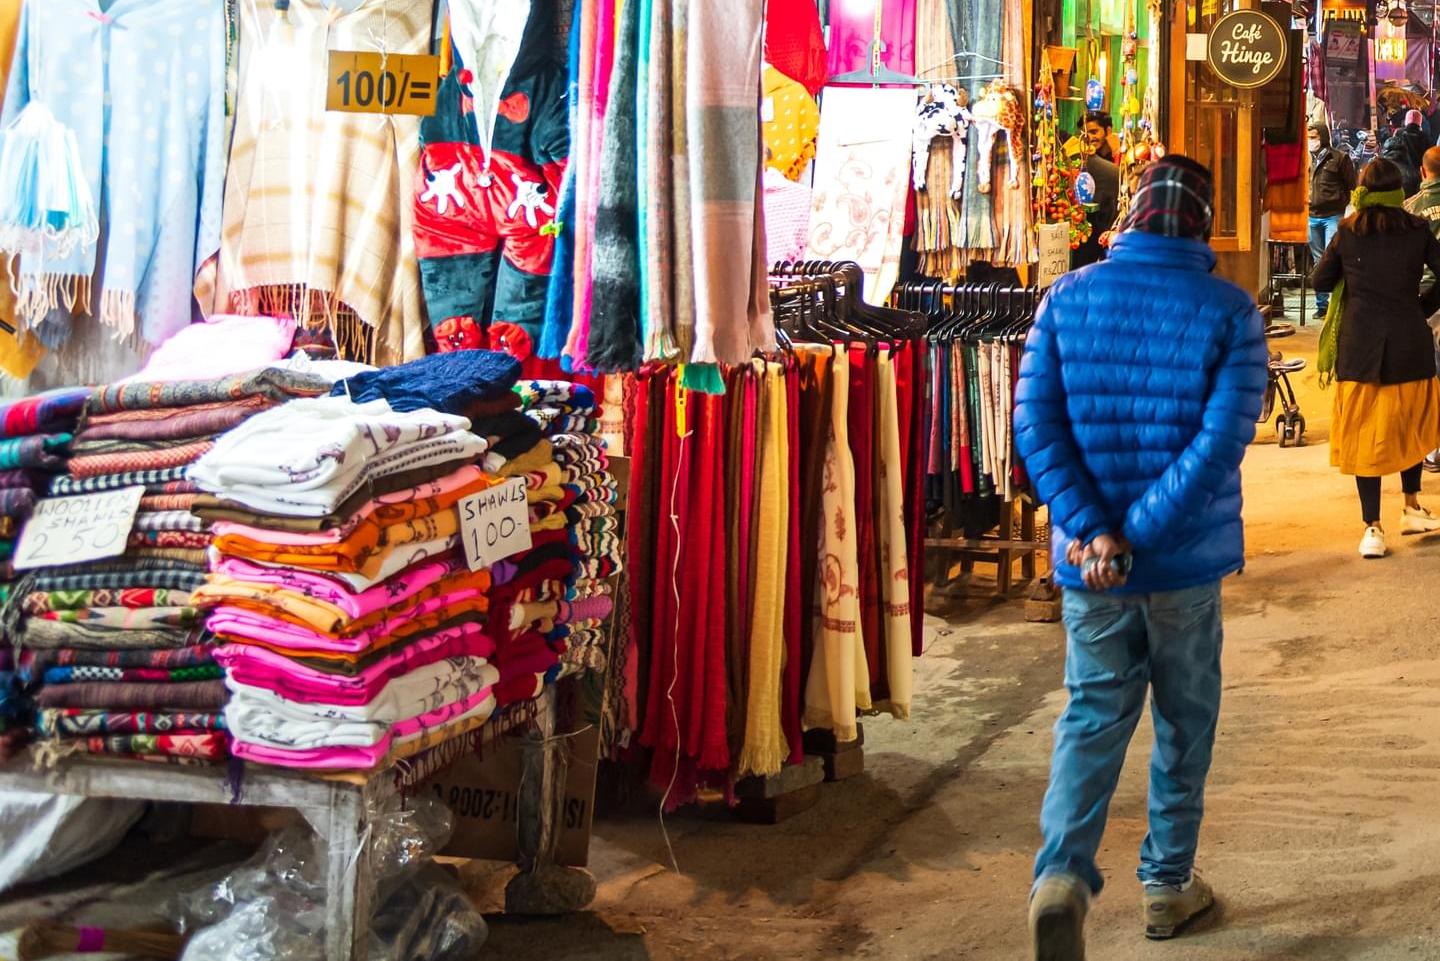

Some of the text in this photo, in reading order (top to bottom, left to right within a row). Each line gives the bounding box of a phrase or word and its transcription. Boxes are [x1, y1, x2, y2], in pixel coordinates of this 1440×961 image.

[1232, 23, 1262, 44] Café
[1221, 40, 1273, 74] Hinge
[336, 70, 431, 108] 100/=
[464, 484, 526, 520] SHAWLS
